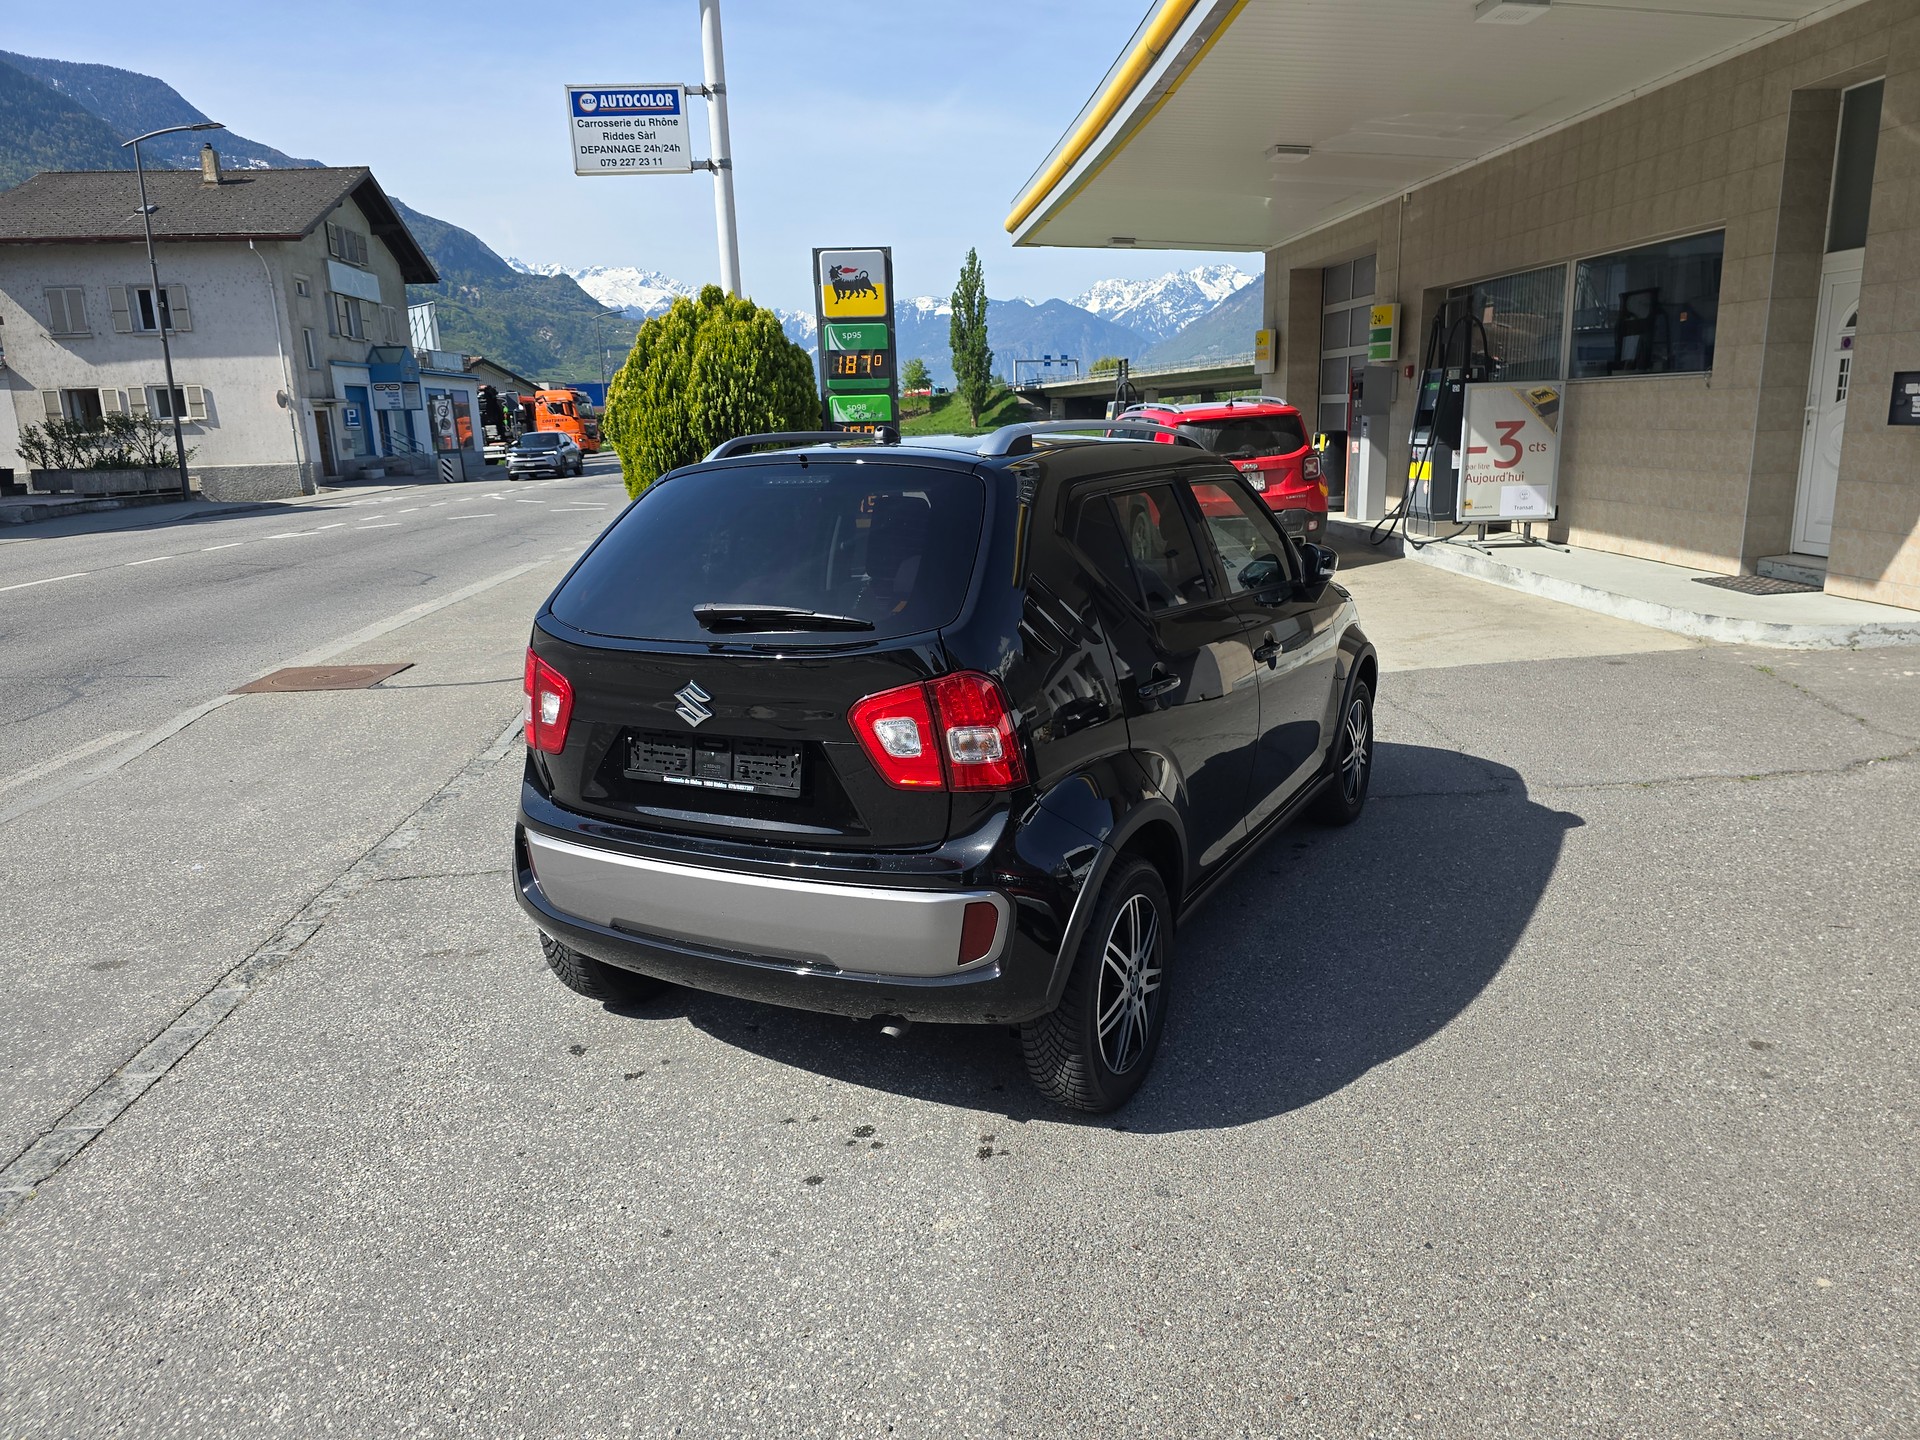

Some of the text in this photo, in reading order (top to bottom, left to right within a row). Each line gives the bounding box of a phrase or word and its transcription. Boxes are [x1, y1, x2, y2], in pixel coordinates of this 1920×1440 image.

[599, 94, 674, 107] AUTOCOLOR
[577, 117, 679, 128] Carrosserie du Rhône
[602, 131, 656, 141] Riddes Sàrl
[580, 144, 681, 154] DEPANNAGE 24h/24h
[600, 158, 617, 167] 079
[619, 158, 636, 166] 227
[639, 158, 650, 166] 23
[842, 332, 862, 340] sp95
[846, 403, 867, 412] sp98
[347, 409, 356, 422] P
[1528, 441, 1547, 453] cts
[1464, 471, 1525, 485] Aujourd'hui
